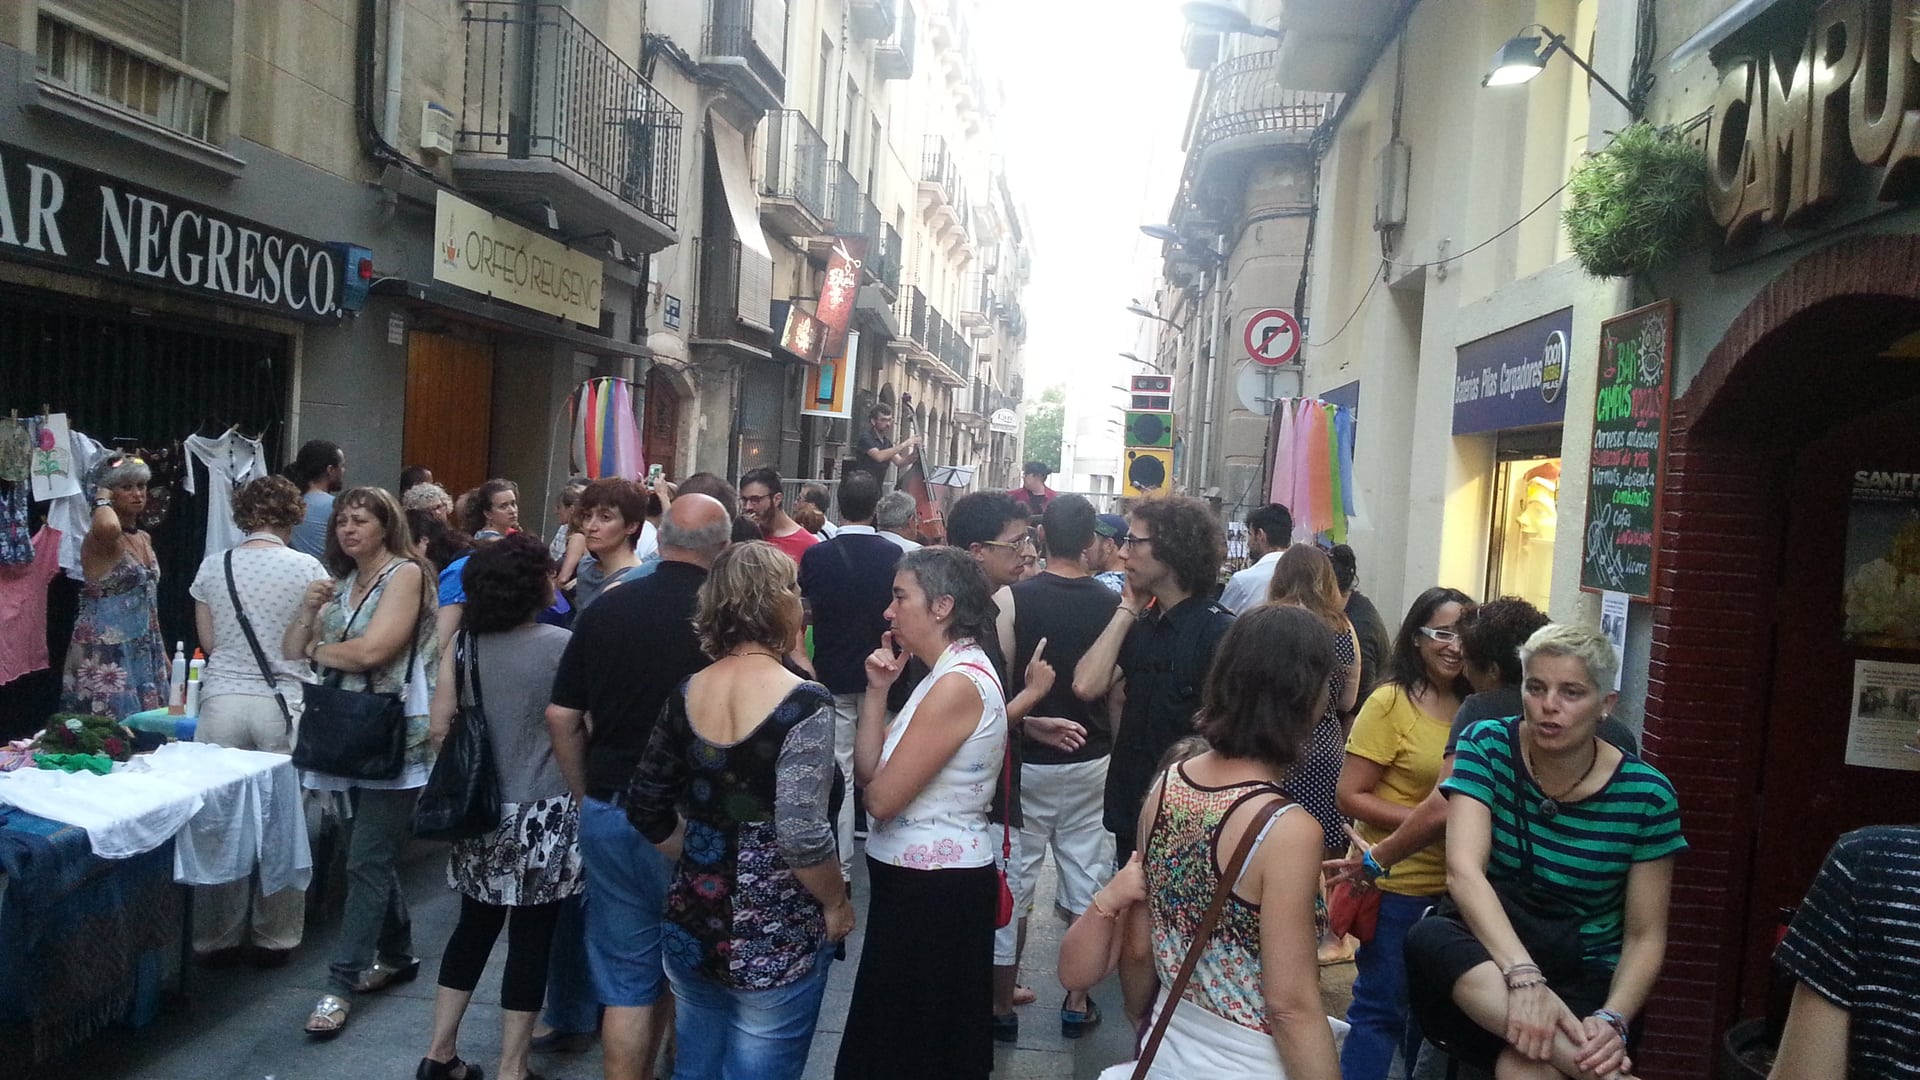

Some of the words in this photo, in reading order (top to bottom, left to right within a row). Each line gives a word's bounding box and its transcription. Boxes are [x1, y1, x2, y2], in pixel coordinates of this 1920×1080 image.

[96, 185, 335, 316] NEGRESCO
[466, 231, 529, 287] ORFEÓ
[530, 255, 599, 311] REUSENC
[1545, 343, 1562, 366] 1001
[1616, 339, 1638, 384] BAR
[1481, 367, 1498, 398] Pilas
[1500, 357, 1543, 399] Cargadores
[1542, 380, 1560, 391] PILAS
[1597, 384, 1632, 421] CAMPUS
[1854, 470, 1911, 489] SANT
